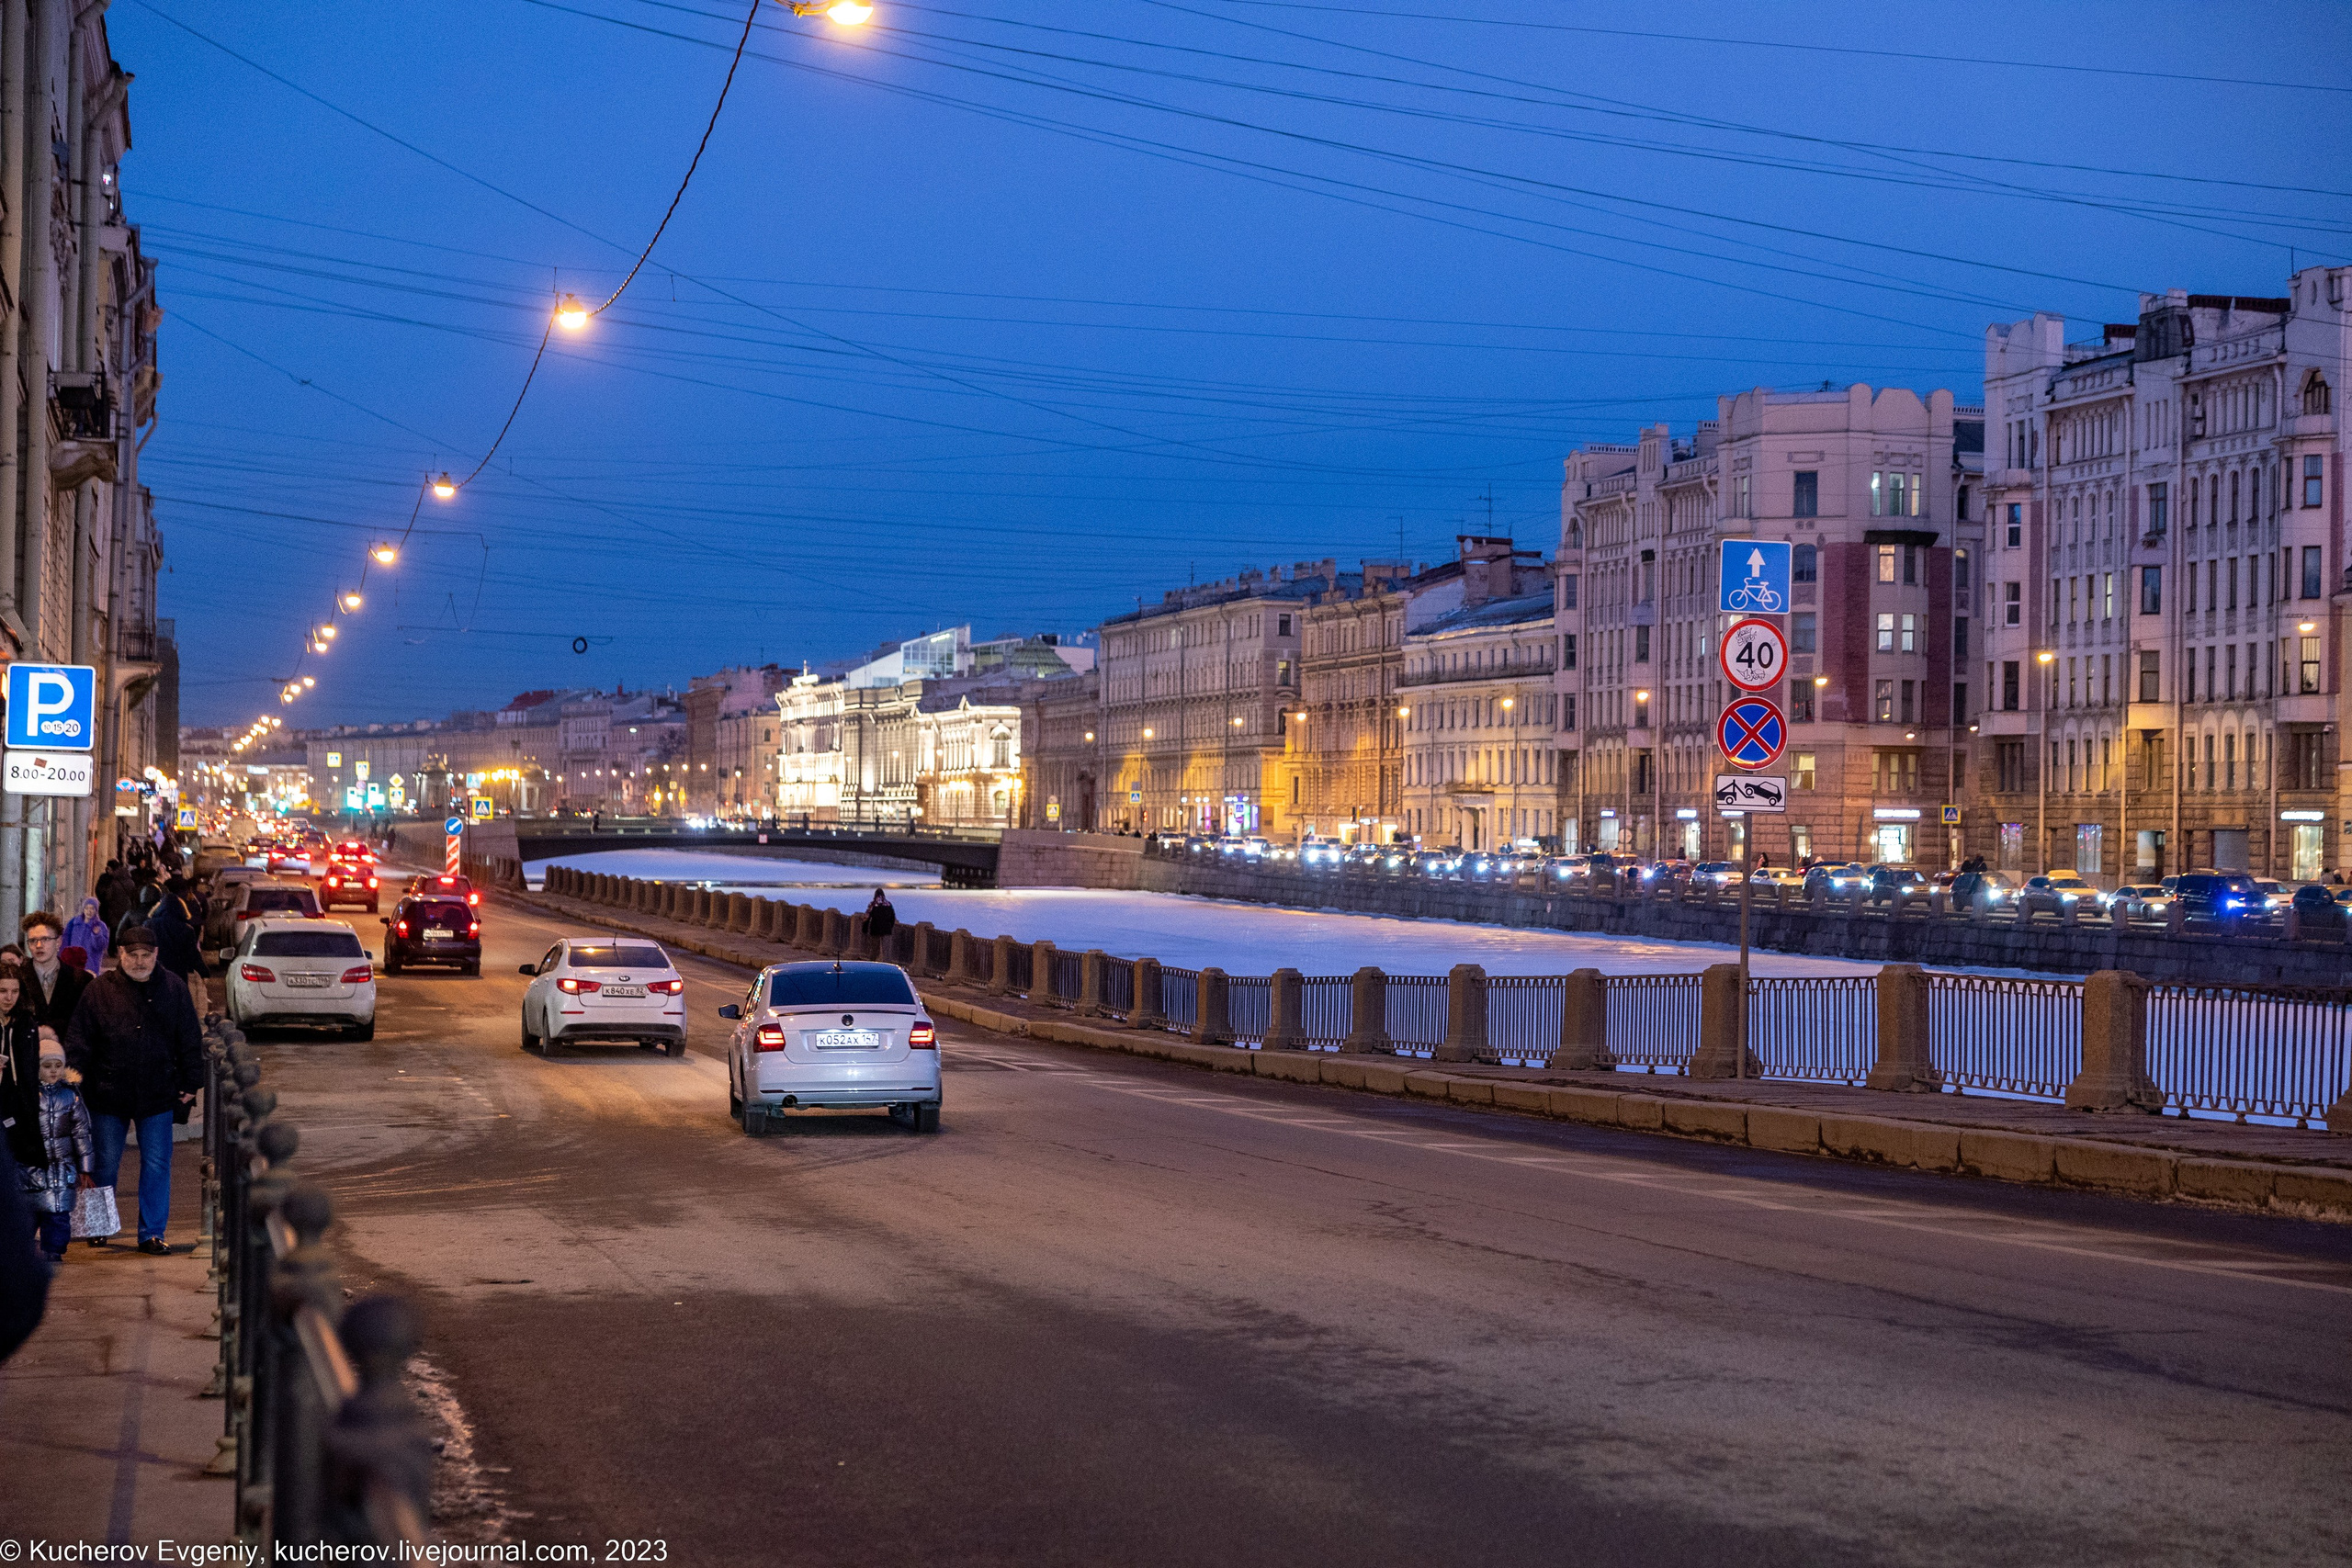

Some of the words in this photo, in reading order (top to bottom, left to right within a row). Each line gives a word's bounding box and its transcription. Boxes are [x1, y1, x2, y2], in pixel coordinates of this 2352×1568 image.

[1736, 641, 1774, 669] 40
[27, 671, 74, 737] P
[53, 723, 62, 731] 15
[65, 723, 79, 733] 20
[10, 765, 85, 782] 8.00-20.00
